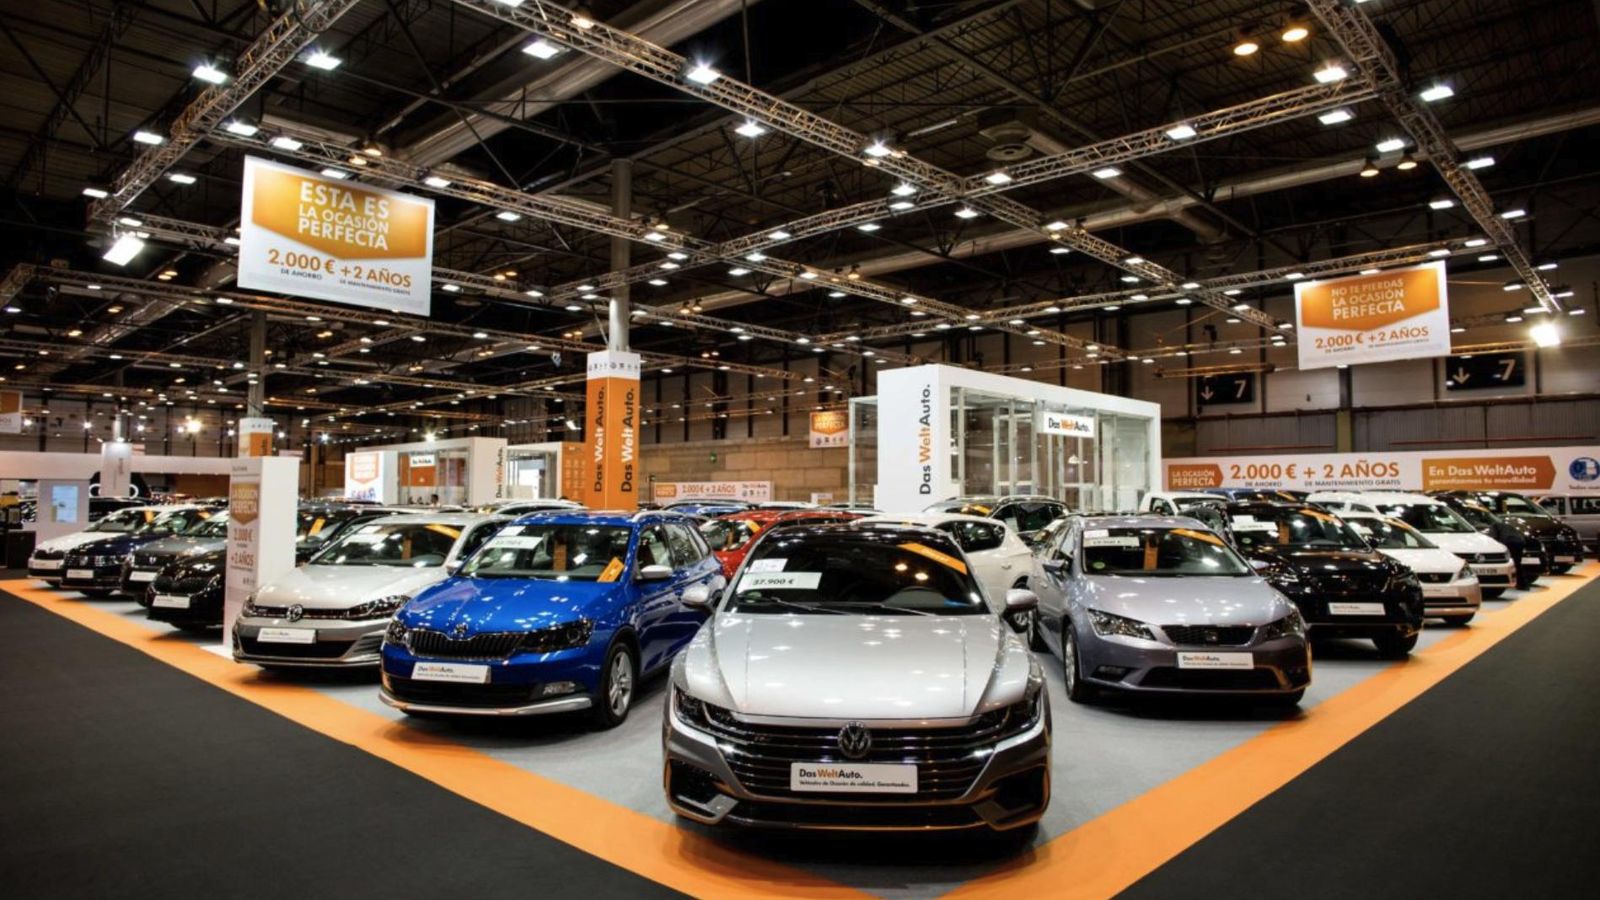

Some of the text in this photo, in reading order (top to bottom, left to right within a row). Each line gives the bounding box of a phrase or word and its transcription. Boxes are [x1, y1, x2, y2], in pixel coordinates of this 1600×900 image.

[300, 180, 390, 219] ESTA ES
[299, 203, 389, 234] LA OCASIÓN
[298, 217, 388, 251] PERFECTA
[268, 249, 321, 271] 2.000
[324, 259, 335, 274] €
[366, 268, 411, 288] AÑOS
[291, 270, 322, 281] AHORRO
[1331, 278, 1404, 297] NO TE PIERDAS
[1332, 288, 1404, 308] LA OCASIÓN
[1333, 300, 1405, 320] PERFECTA
[1315, 334, 1353, 349] 2.000
[1356, 333, 1364, 344] €
[1389, 326, 1429, 341] AÑOS
[1498, 359, 1516, 381] 7
[1234, 380, 1246, 398] 7
[1048, 417, 1060, 428] Das
[594, 464, 603, 492] Das
[620, 464, 633, 492] Das
[1183, 469, 1215, 477] OCASIÓN
[1230, 460, 1399, 479] 2.000 € + 2 AÑOS
[1429, 464, 1537, 476] En Das WeltAuto
[919, 465, 931, 495] Das
[1172, 477, 1215, 487] PERFECTA
[1494, 476, 1537, 484] movilidad
[799, 768, 817, 778] Das
